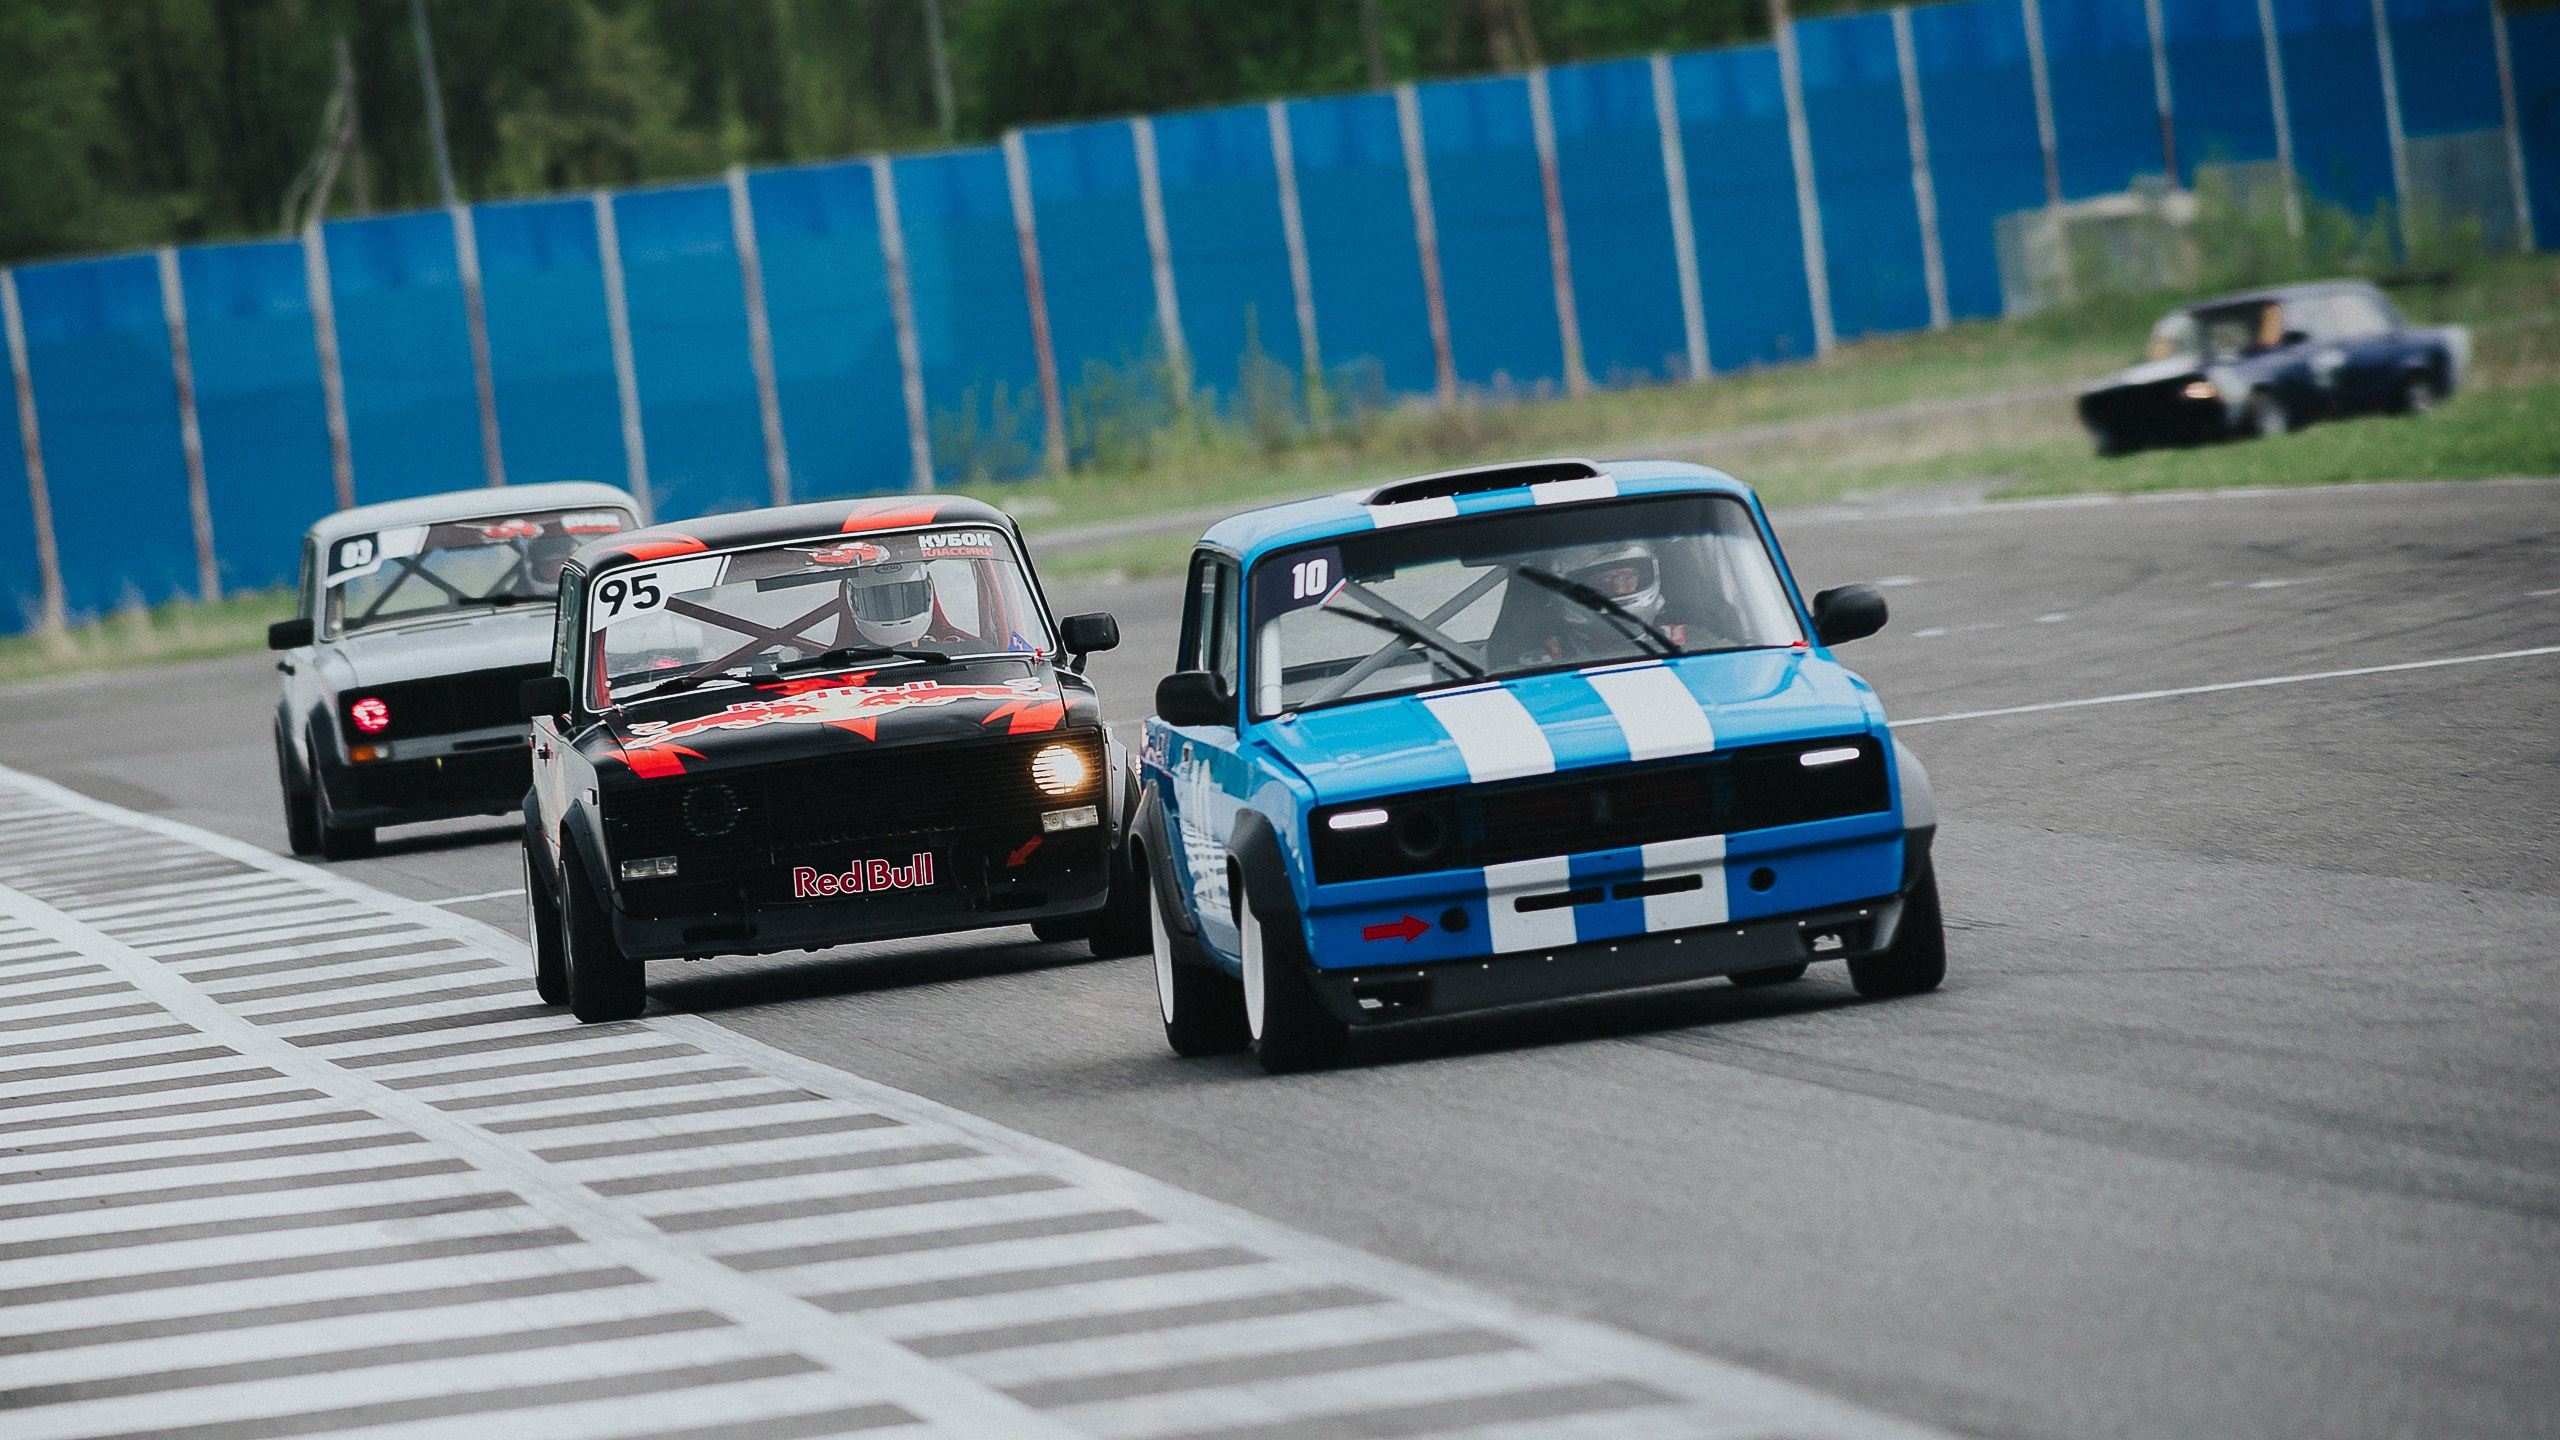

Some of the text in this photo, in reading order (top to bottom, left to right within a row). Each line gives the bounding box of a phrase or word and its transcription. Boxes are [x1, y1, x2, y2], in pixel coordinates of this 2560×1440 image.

[918, 532, 993, 548] КУБОК
[921, 547, 995, 557] КЛАССИКИ
[599, 573, 661, 617] 95
[1292, 559, 1328, 600] 10
[793, 852, 934, 898] Red Bull
